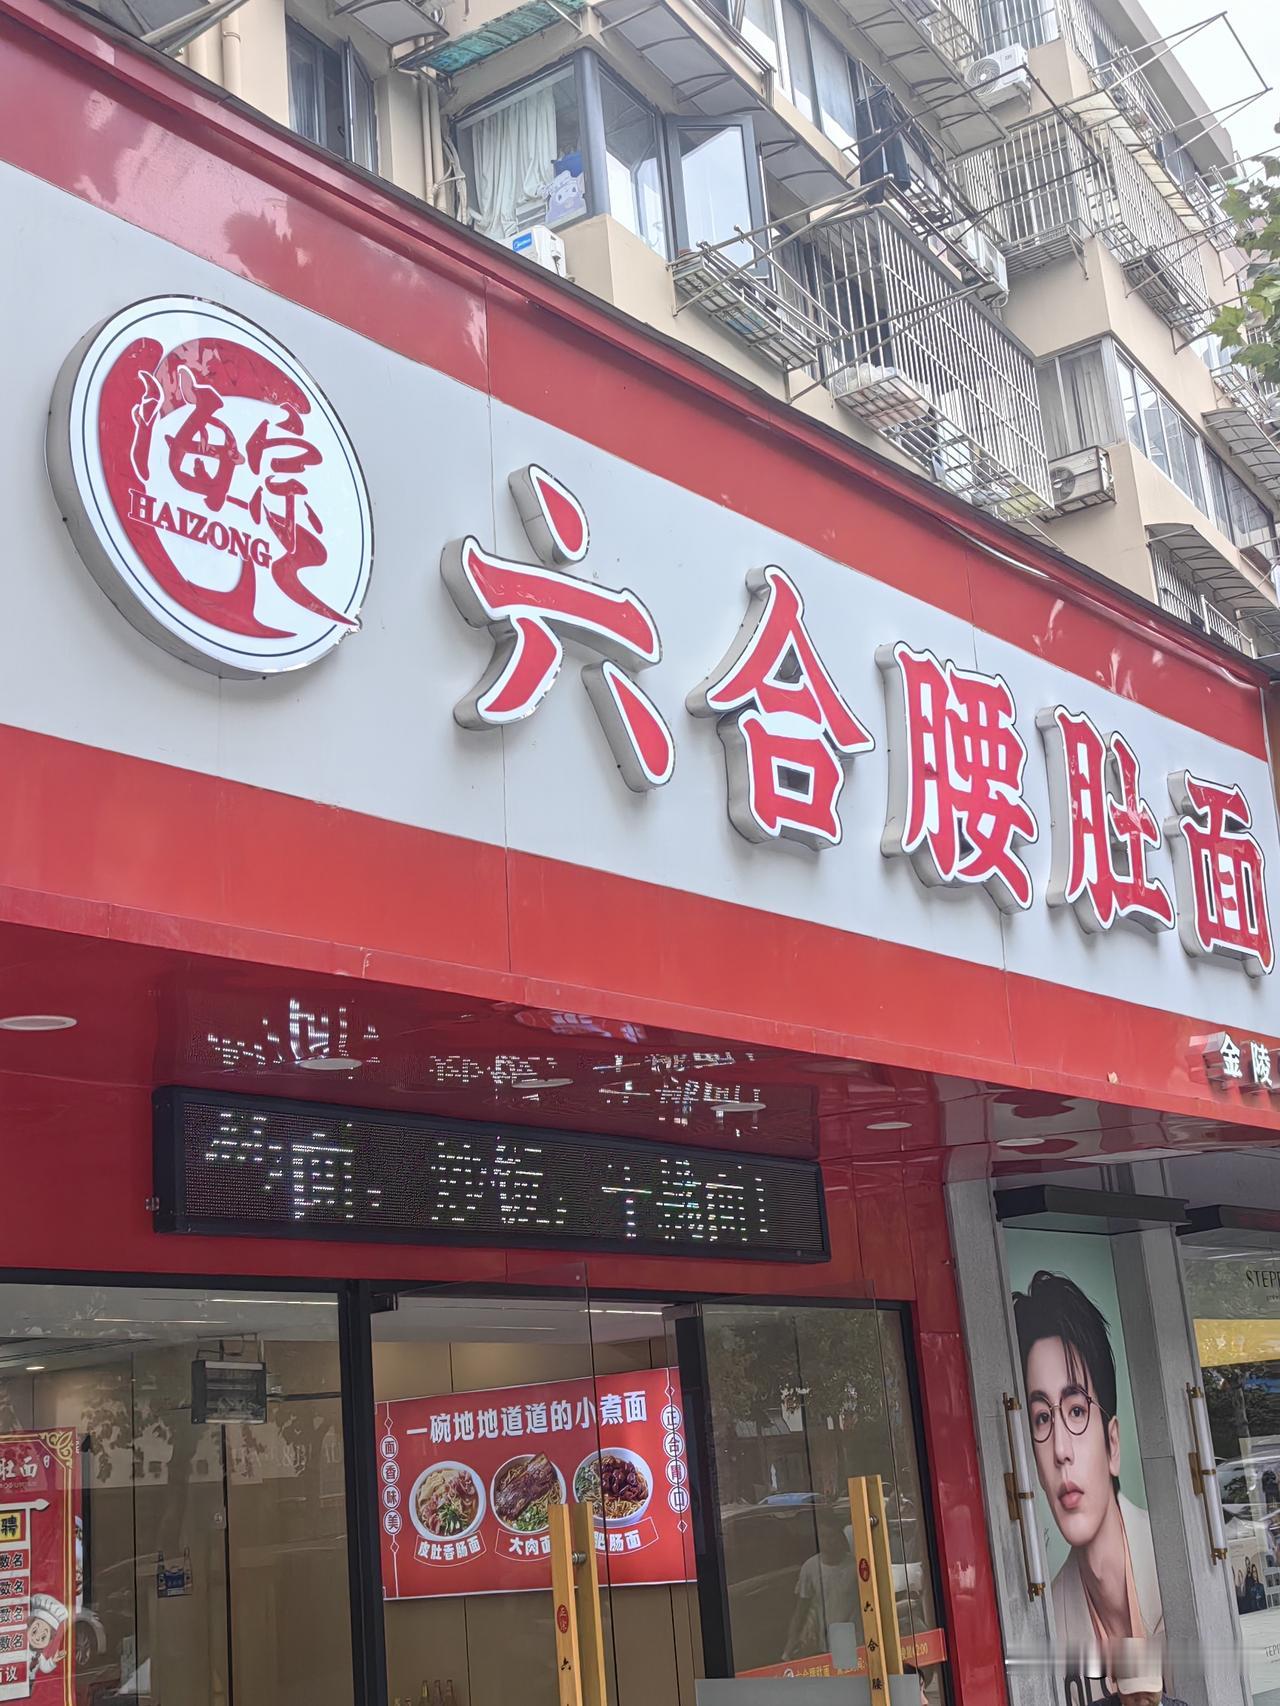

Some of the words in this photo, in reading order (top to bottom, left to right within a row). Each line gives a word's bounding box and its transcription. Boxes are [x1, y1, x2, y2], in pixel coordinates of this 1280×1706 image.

[128, 489, 273, 569] HAIZONG
[458, 464, 1276, 977] 六合腰肚面
[1219, 1032, 1274, 1088] 金陵
[1246, 1269, 1280, 1288] STEP
[406, 1390, 648, 1444] 一碗地地道道的小煮面
[383, 1439, 400, 1531] 面香味美
[664, 1407, 687, 1510] 正合胃口
[0, 1666, 18, 1682] 议
